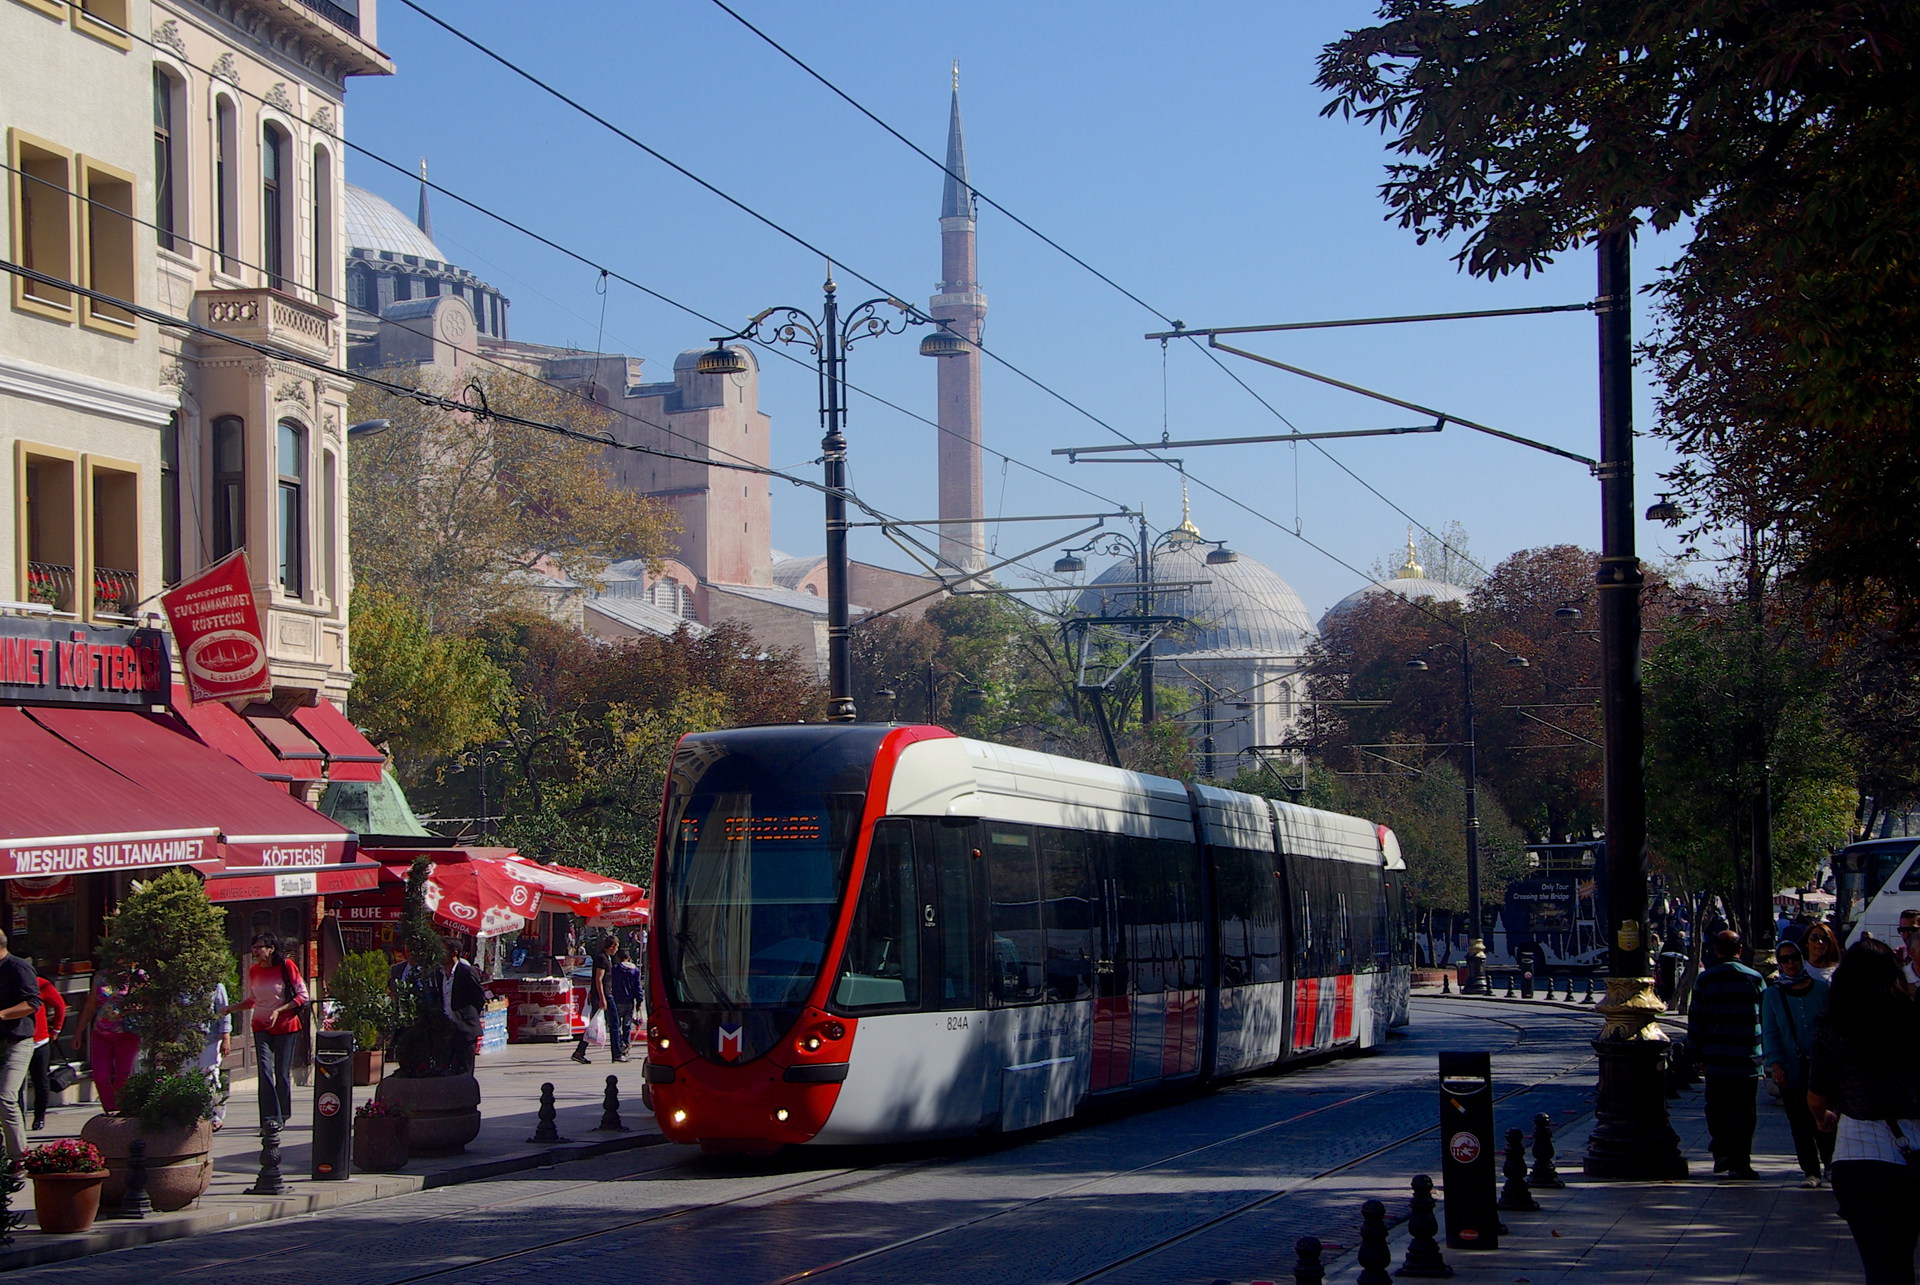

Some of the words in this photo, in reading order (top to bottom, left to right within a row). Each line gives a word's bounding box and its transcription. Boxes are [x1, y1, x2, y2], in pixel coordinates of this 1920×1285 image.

[174, 593, 251, 618] SULTANAHMET
[16, 847, 89, 873] MEŞHUR
[92, 840, 204, 866] SULTANAHMET
[1541, 883, 1555, 891] Only
[1513, 893, 1538, 901] Crossing
[1550, 893, 1570, 901] Bridge
[442, 920, 470, 934] ALGIDA
[946, 1016, 969, 1030] 824A
